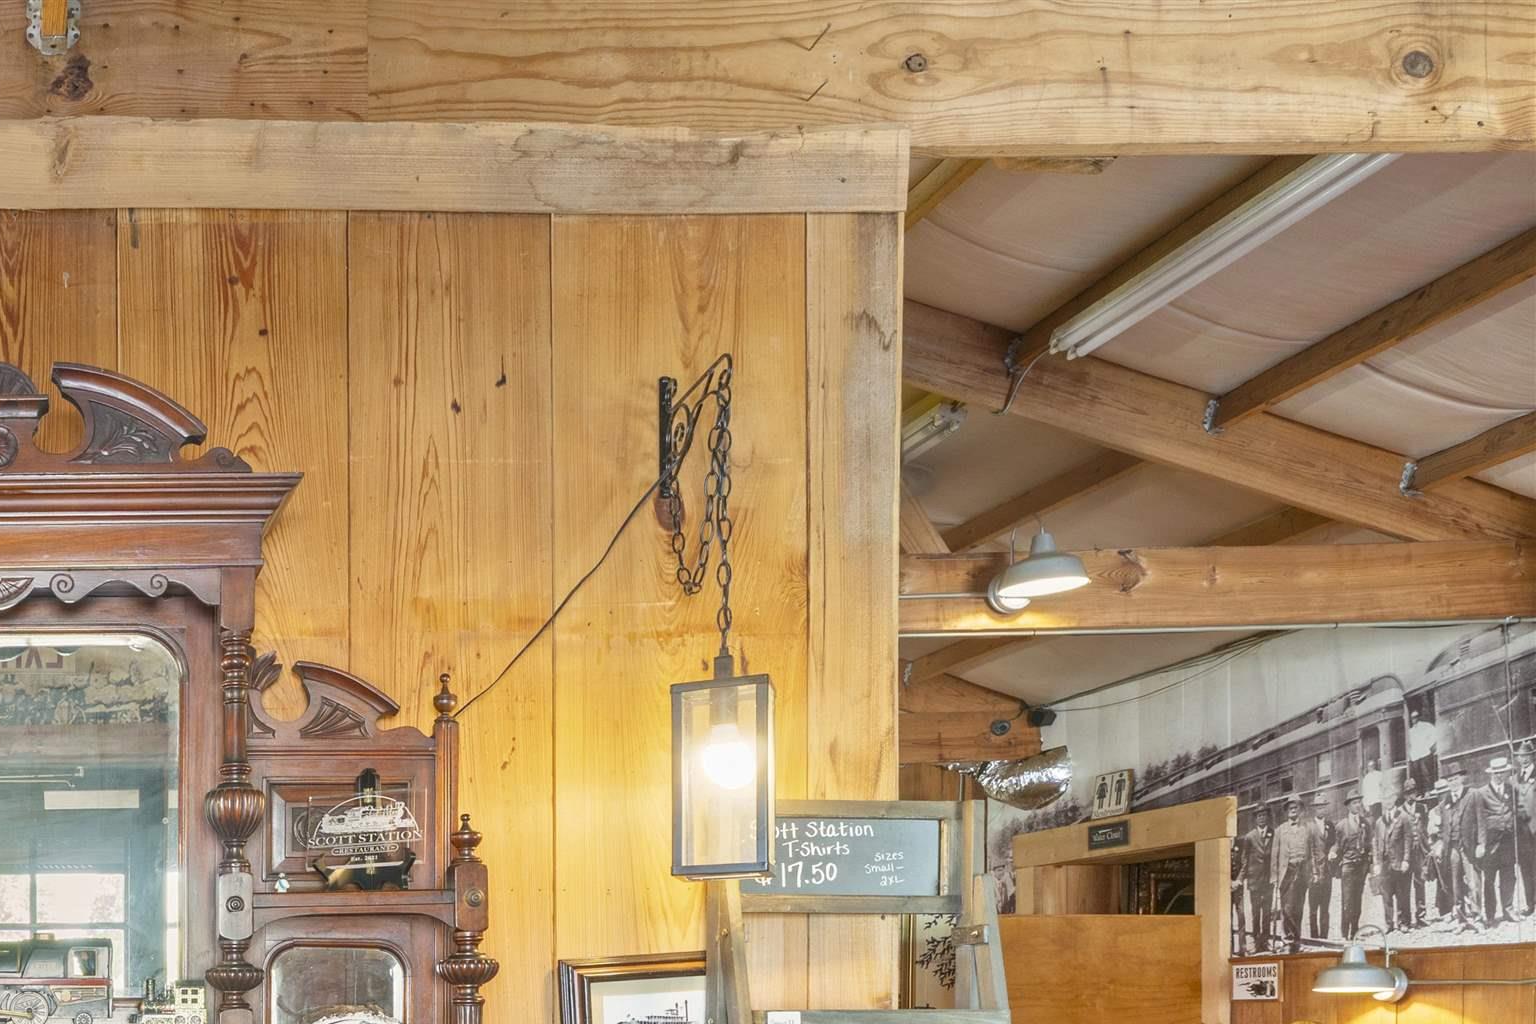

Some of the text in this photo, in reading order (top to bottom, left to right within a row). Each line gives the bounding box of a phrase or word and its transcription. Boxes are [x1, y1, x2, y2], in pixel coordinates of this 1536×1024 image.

[308, 829, 424, 847] SCOTT STATION
[805, 821, 874, 838] Station
[781, 839, 850, 858] T-Shirts
[1235, 966, 1277, 979] RESTROOMS
